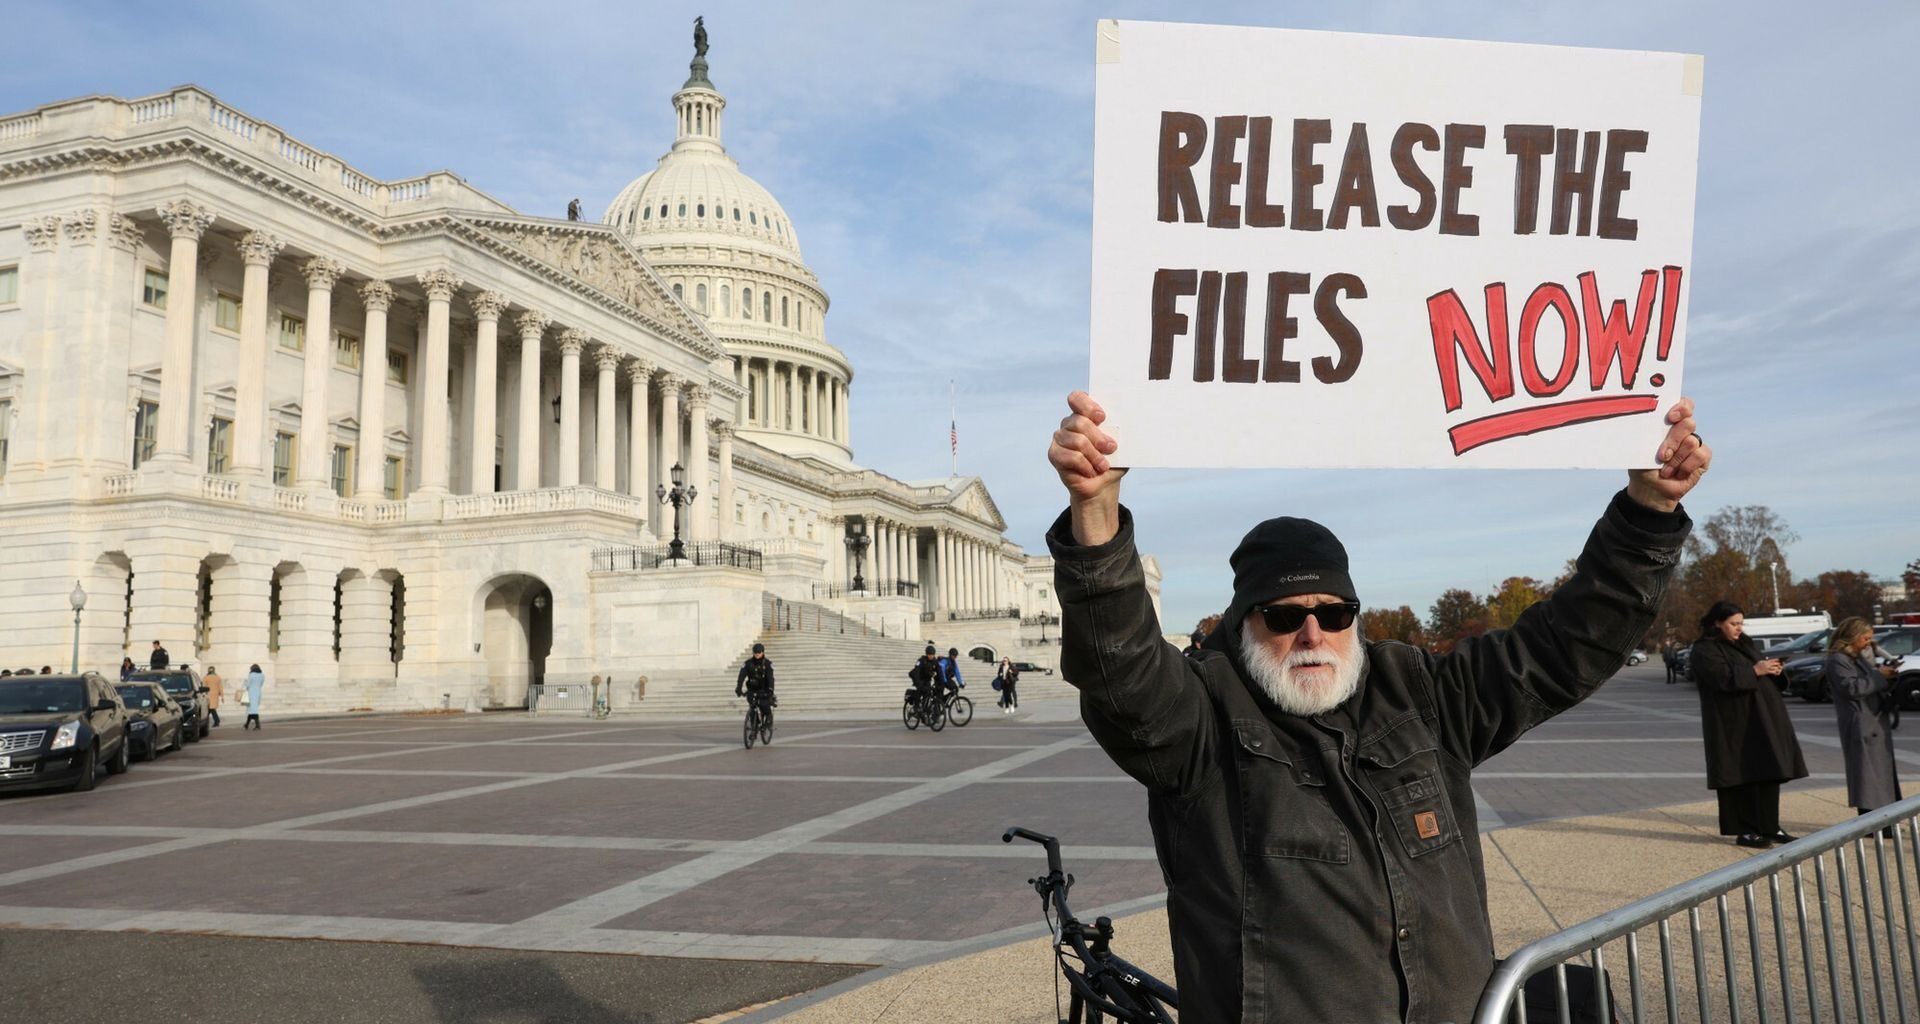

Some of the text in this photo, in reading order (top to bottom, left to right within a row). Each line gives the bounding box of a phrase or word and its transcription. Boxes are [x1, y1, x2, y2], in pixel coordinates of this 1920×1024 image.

[1157, 110, 1649, 241] RELEASE THE
[1148, 264, 1683, 413] FILES NOW!
[1287, 573, 1320, 582] Columbia
